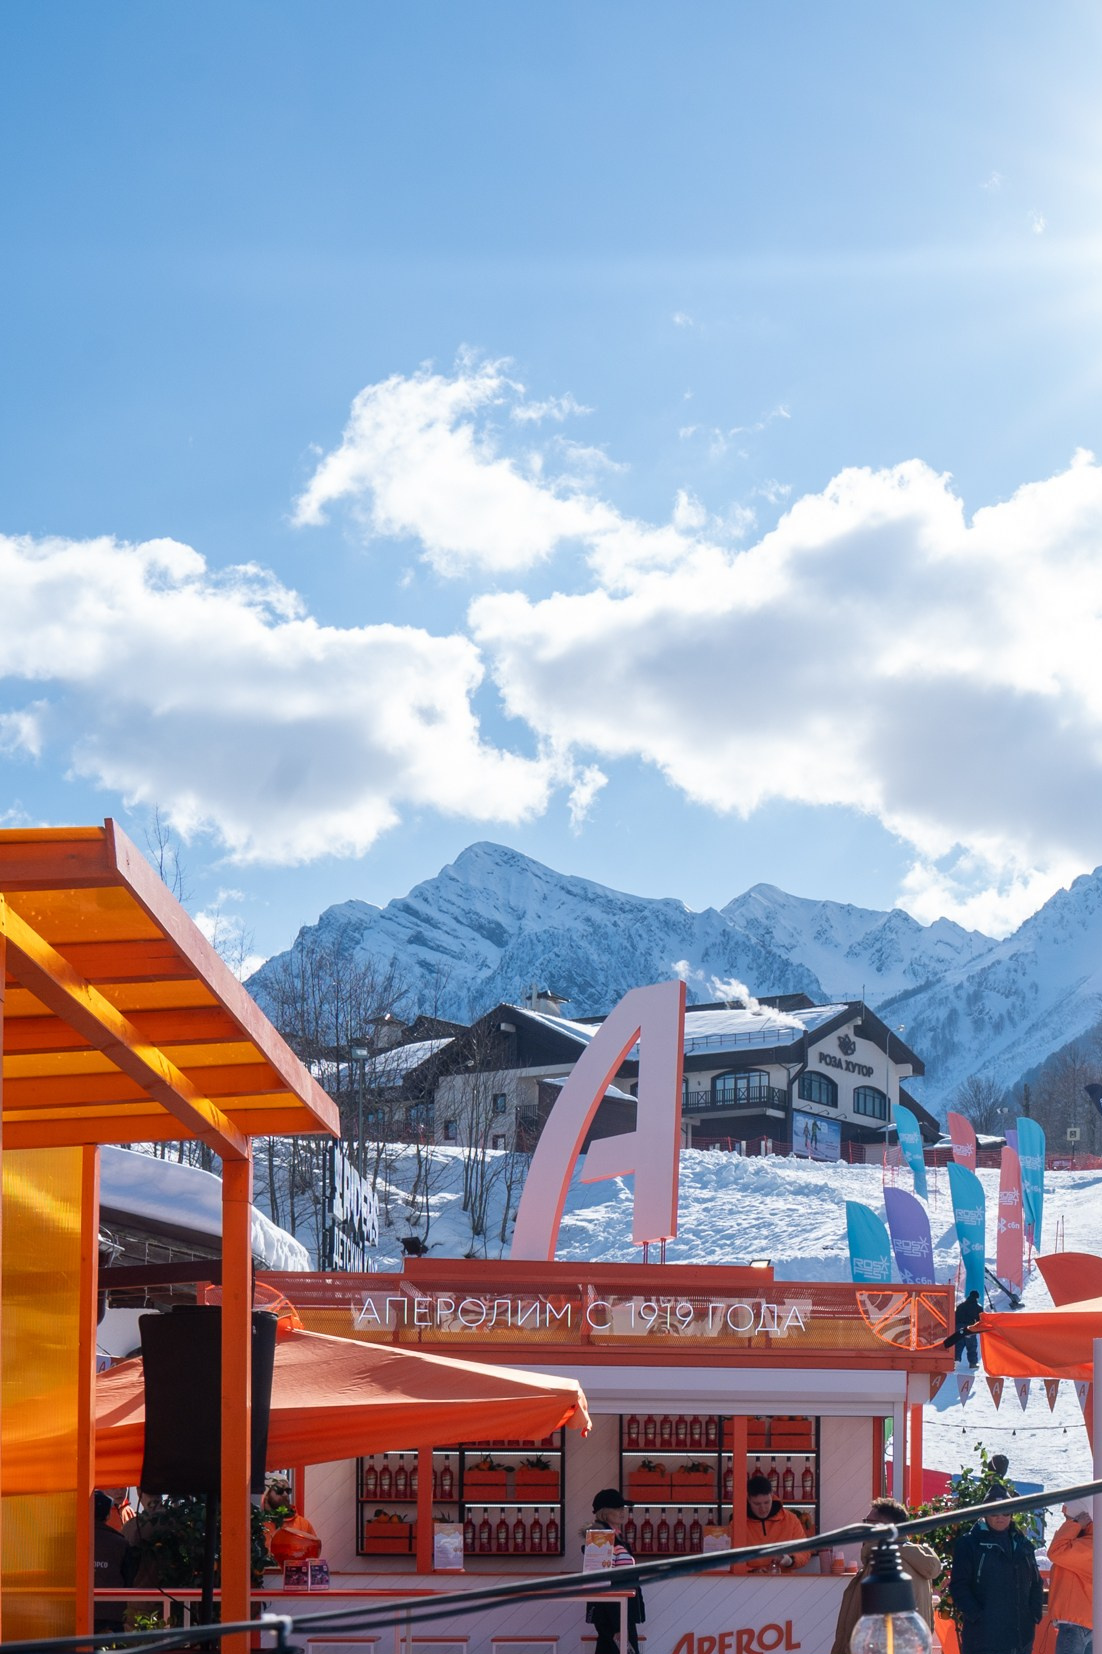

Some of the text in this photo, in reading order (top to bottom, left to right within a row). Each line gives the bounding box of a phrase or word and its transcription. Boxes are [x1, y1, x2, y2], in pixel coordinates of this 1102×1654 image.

[818, 1051, 874, 1078] РОЗА ХУТОР
[358, 1297, 806, 1336] АПЕРОЛИМ С 1919 ГОДА
